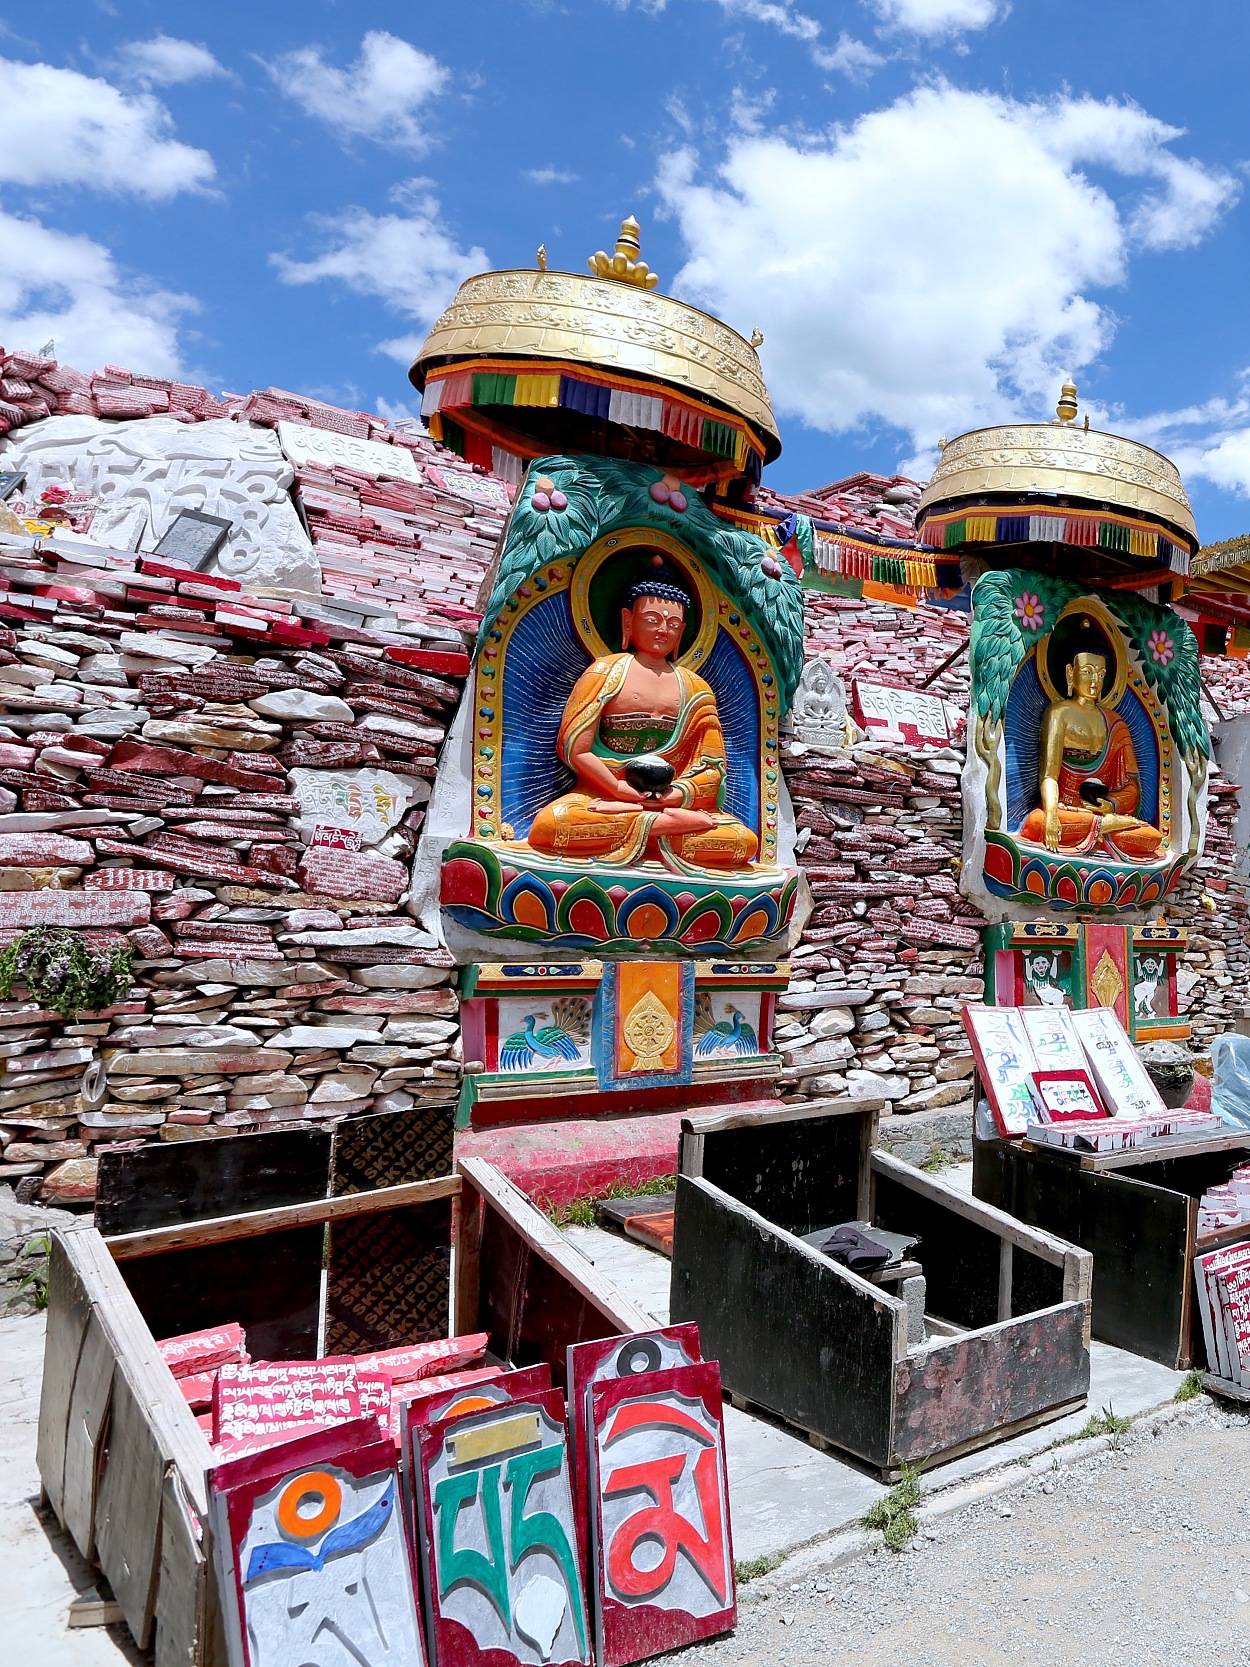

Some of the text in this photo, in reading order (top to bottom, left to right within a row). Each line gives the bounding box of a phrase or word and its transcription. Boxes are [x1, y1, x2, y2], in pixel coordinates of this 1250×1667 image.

[438, 788, 457, 800] 2015
[364, 1110, 438, 1180] SKYFORM
[375, 1119, 448, 1188] SKYFORM
[364, 1250, 438, 1324] SKYFORM
[376, 1258, 449, 1334] SKYFORM
